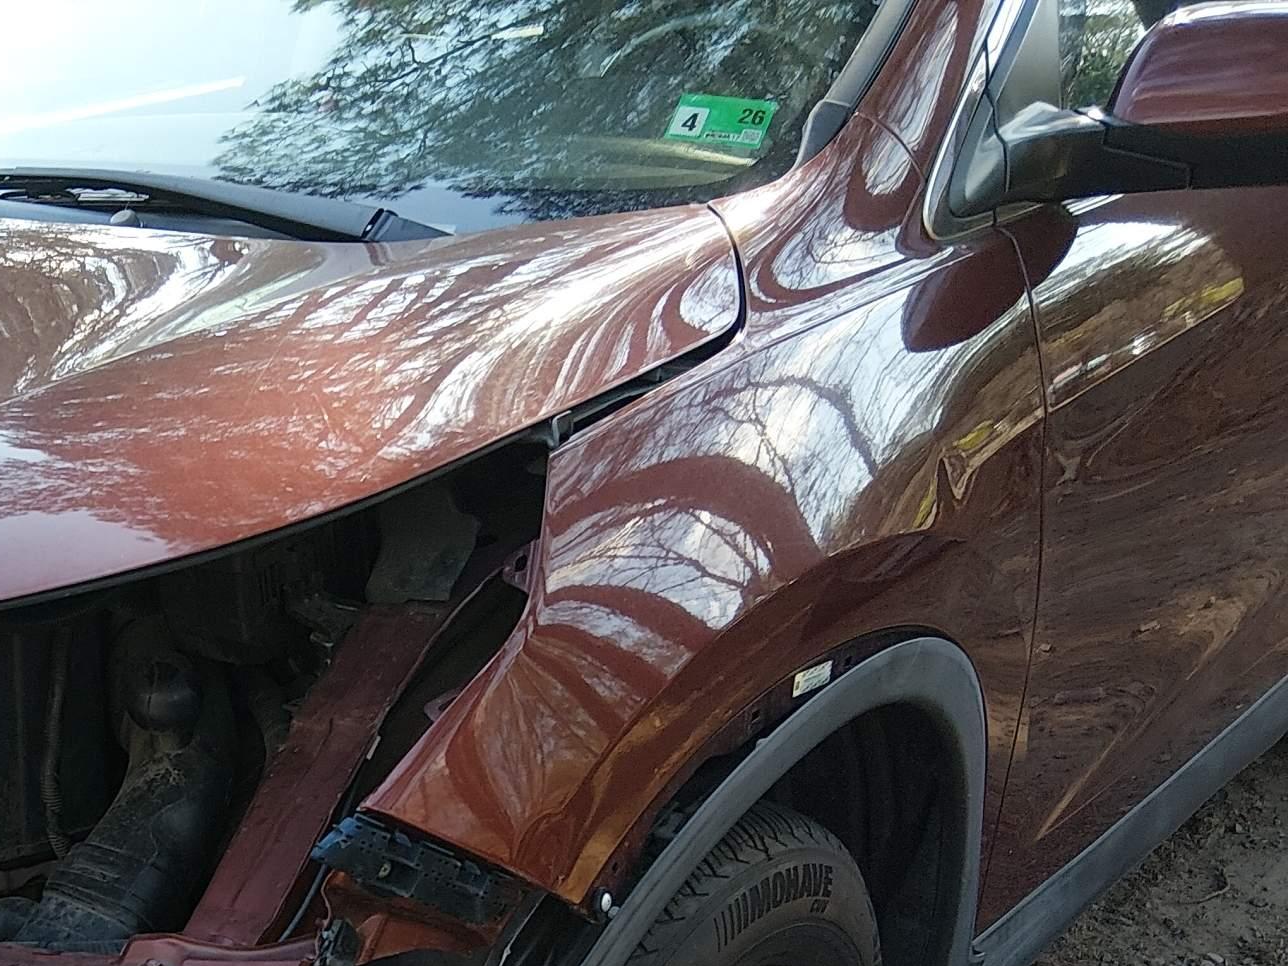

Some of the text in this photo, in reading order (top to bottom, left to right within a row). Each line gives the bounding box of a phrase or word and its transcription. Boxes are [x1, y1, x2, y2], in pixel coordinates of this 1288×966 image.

[680, 108, 766, 131] 4 26
[749, 863, 833, 925] MOHAVE
